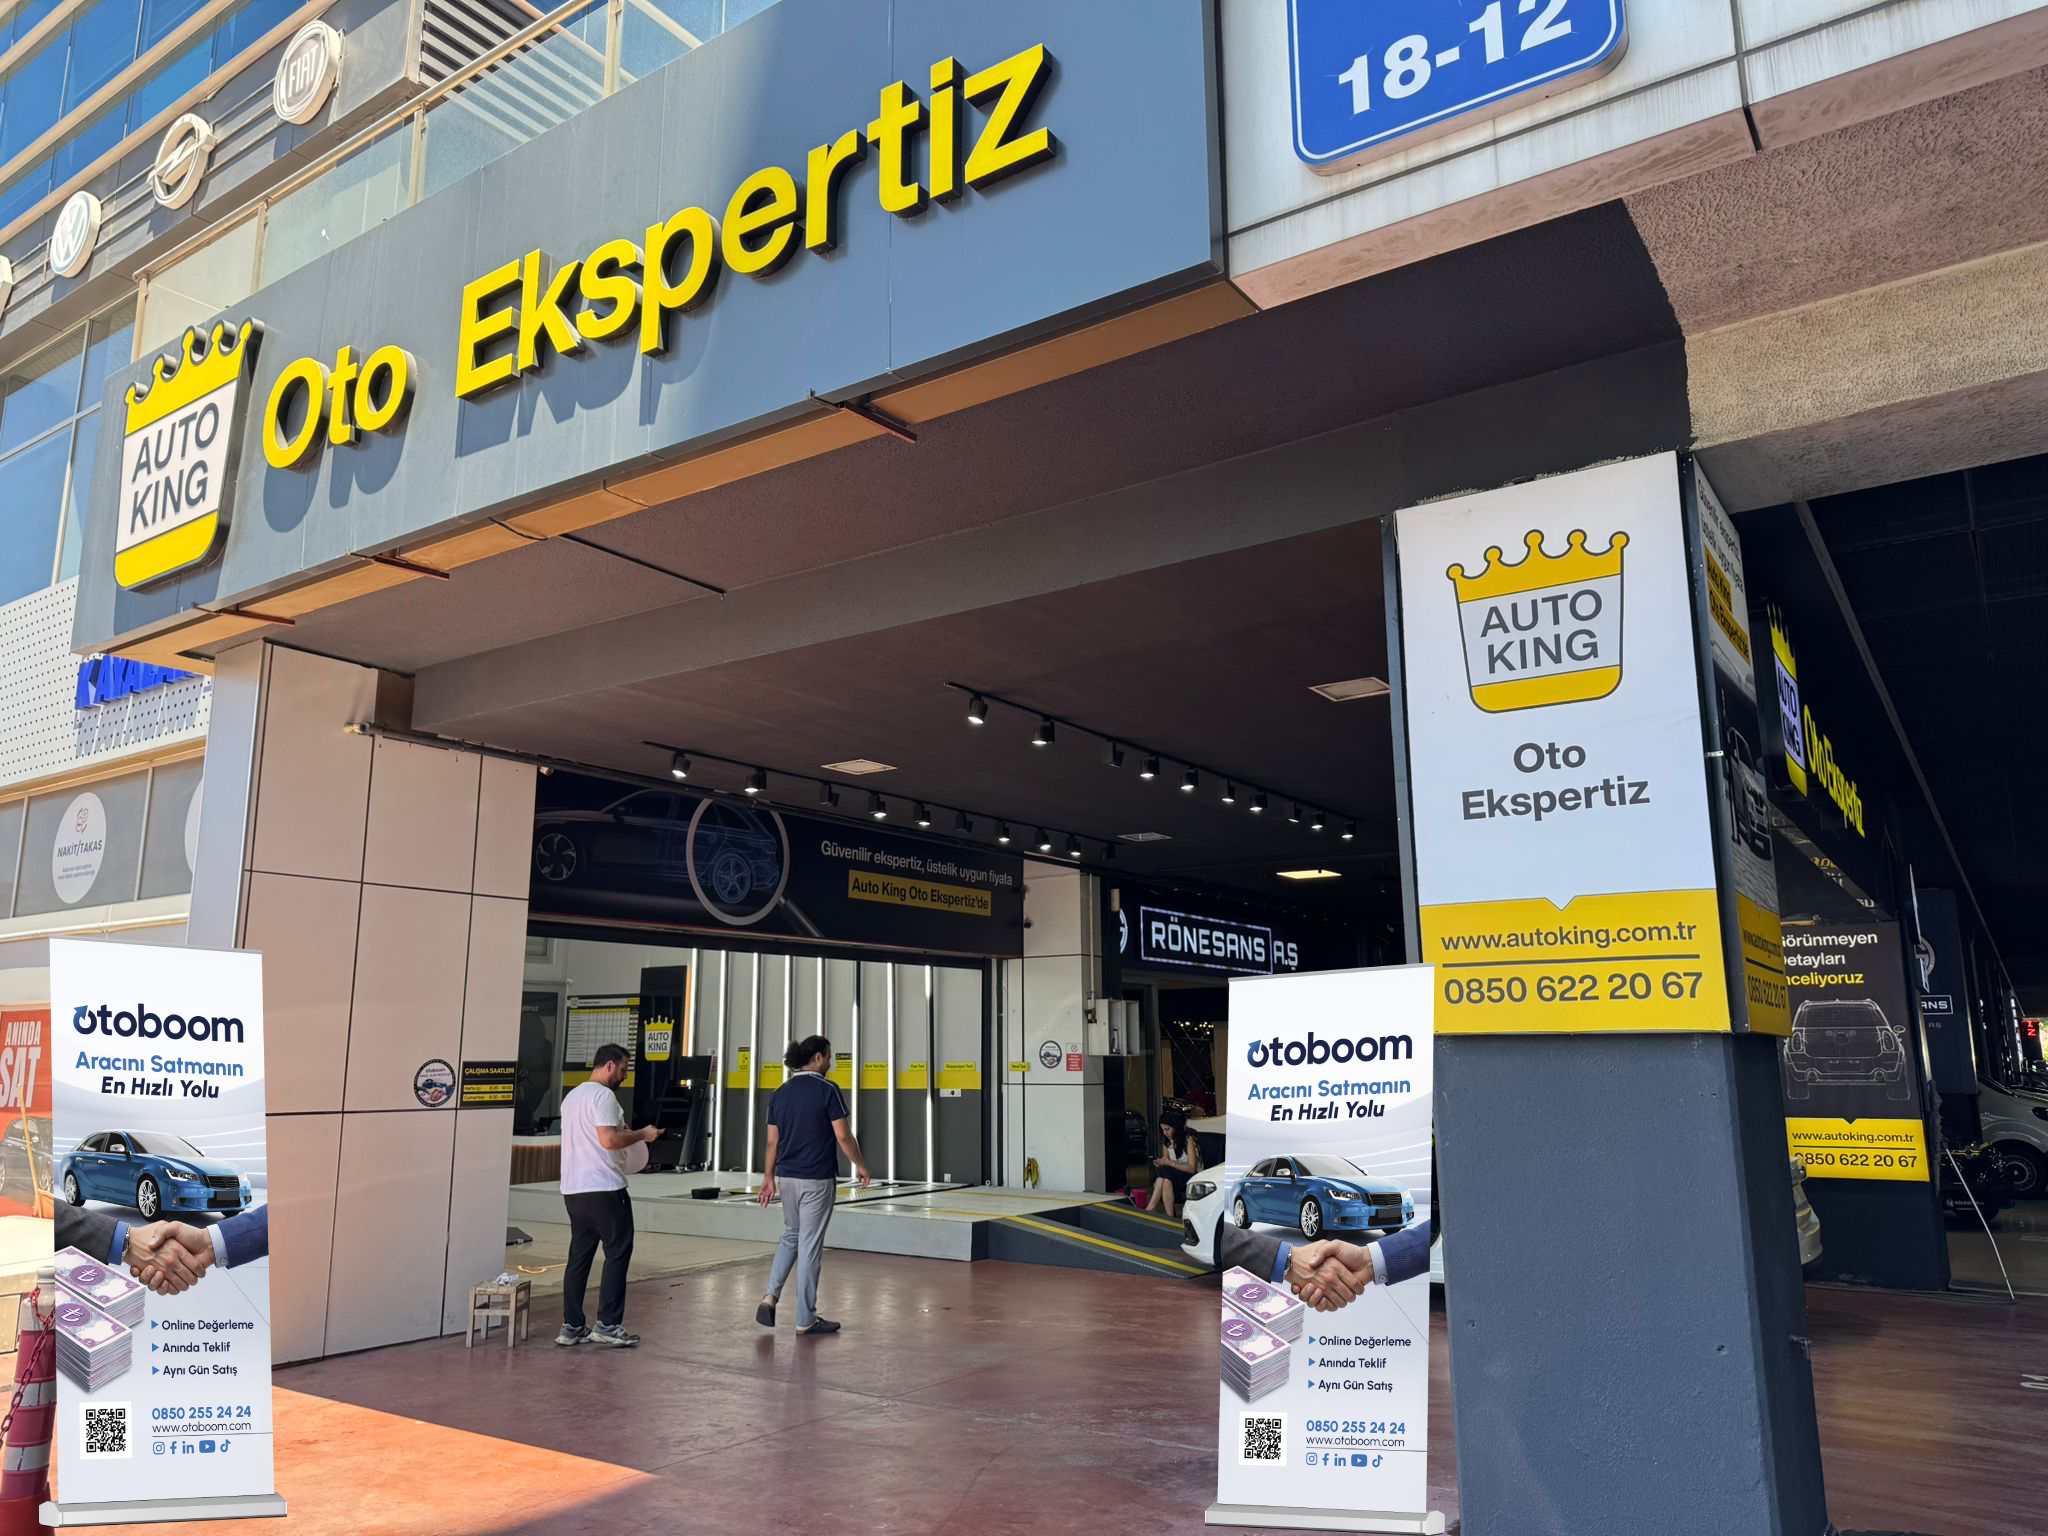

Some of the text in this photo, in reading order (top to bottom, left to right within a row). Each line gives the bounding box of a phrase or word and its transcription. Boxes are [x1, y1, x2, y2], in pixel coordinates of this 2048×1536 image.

[1338, 0, 1572, 115] 18-12
[289, 44, 320, 98] FIAT
[262, 42, 1059, 469] Oto Ekspertiz
[135, 401, 220, 476] AUTO
[130, 459, 210, 535] KING
[1480, 589, 1602, 637] AUTO
[1487, 630, 1600, 674] KING
[1513, 742, 1586, 773] Oto
[1461, 775, 1651, 821] Ekspertiz
[821, 840, 873, 863] Güvenilir
[874, 850, 925, 872] ekspertiz,
[926, 860, 958, 877] üstelik
[960, 868, 988, 884] uygun
[852, 878, 989, 910] Auto King Oto Ekspertiz'de
[1151, 916, 1299, 971] RÖNESANS A.Ş
[1440, 921, 1697, 950] www.autoking.com.tr
[1443, 971, 1703, 1004] 0850 622 20 67
[4, 1021, 42, 1046] ANINDA
[73, 1003, 244, 1043] otoboom
[648, 1032, 669, 1041] AUTO
[648, 1042, 668, 1051] KING
[1247, 1032, 1413, 1068] otoboom
[75, 1051, 244, 1077] Aracını Satmanın
[0, 1047, 42, 1109] SAT
[101, 1076, 220, 1098] En Hızlı Yolu
[1247, 1079, 1411, 1100] Aracını Satmanın
[1270, 1100, 1385, 1121] En Hızlı Yolu
[1792, 1131, 1914, 1144] www.autoking.com.tr
[1839, 1153, 1869, 1167] 622
[1873, 1154, 1894, 1167] 20
[1898, 1155, 1918, 1168] 67
[162, 1319, 254, 1333] Online Değerleme
[163, 1341, 231, 1353] Anında Teklif
[1319, 1336, 1412, 1349] Online Değerleme
[163, 1364, 238, 1378] Aynı Gün Satış
[1318, 1358, 1387, 1369] Anında Teklif
[1318, 1380, 1393, 1393] Aynı Gün Satış
[152, 1405, 252, 1420] 0850 255 24 24
[152, 1421, 252, 1433] www.otoboom.com
[1306, 1420, 1406, 1435] 0850 255 24 24
[1306, 1436, 1405, 1448] www.otoboom.com
